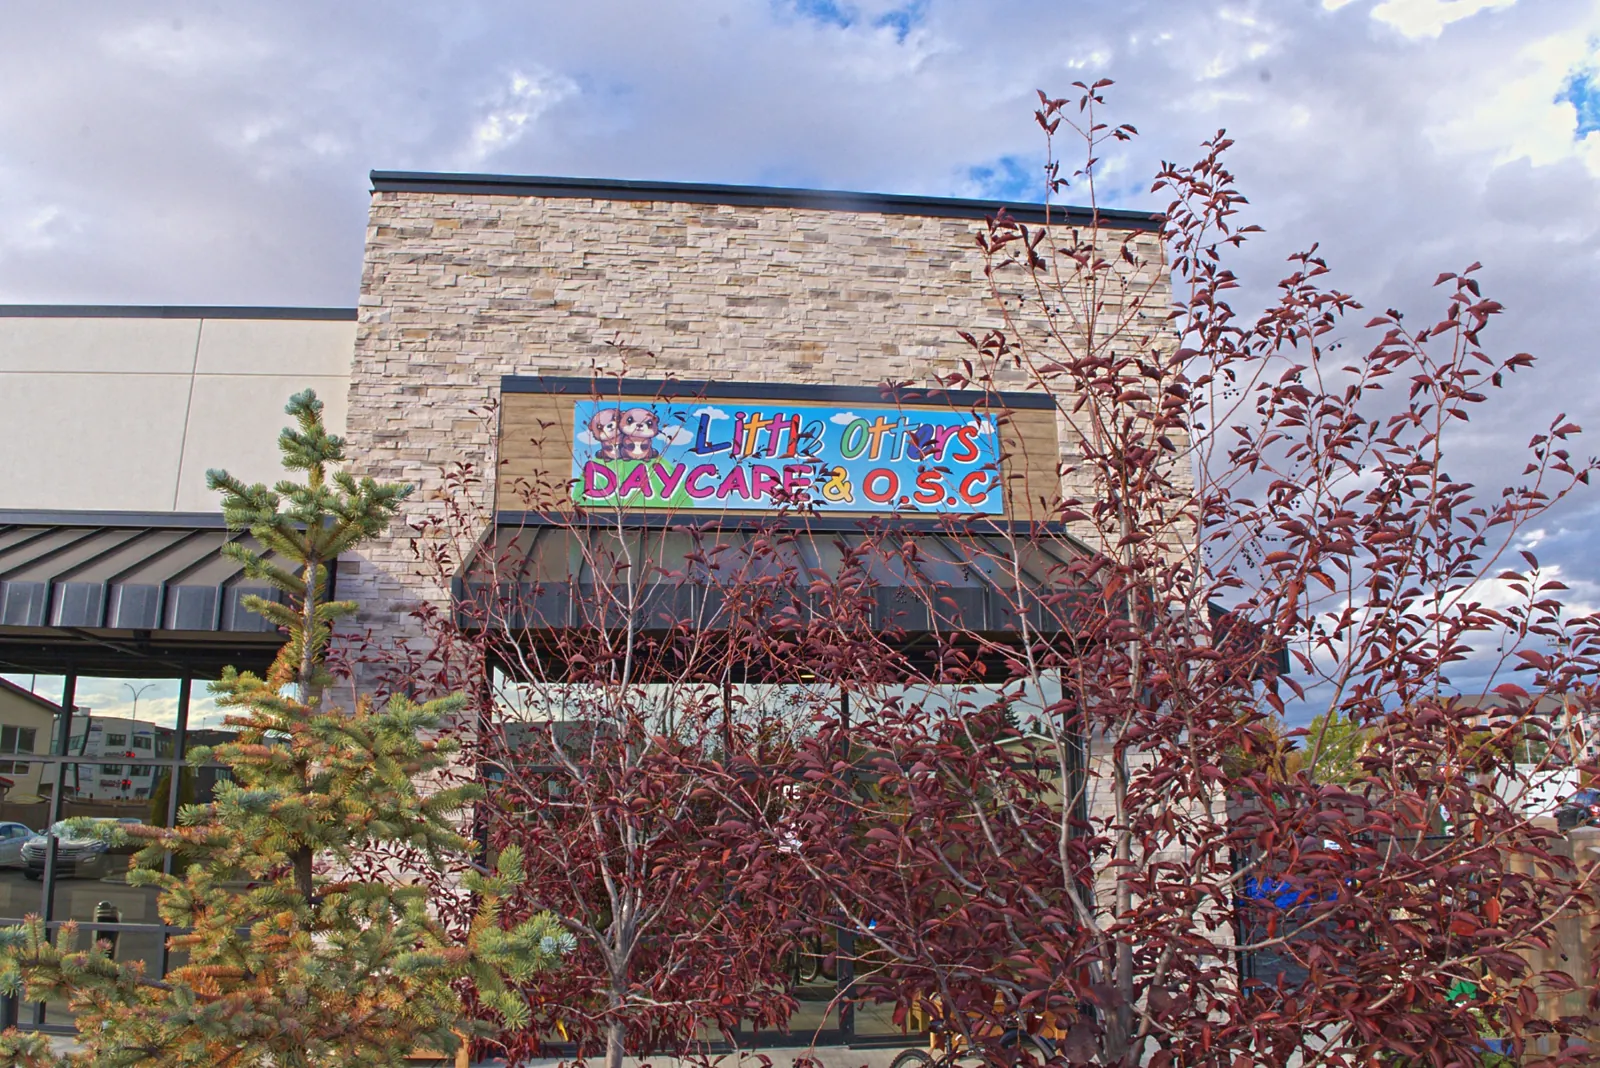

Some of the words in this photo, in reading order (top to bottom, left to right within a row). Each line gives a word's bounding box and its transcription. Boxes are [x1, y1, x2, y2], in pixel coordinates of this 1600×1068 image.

[695, 411, 826, 459] Little
[840, 415, 980, 464] Otters
[583, 460, 813, 503] DAYCARE
[822, 465, 855, 504] &
[862, 467, 988, 507] O.S.C
